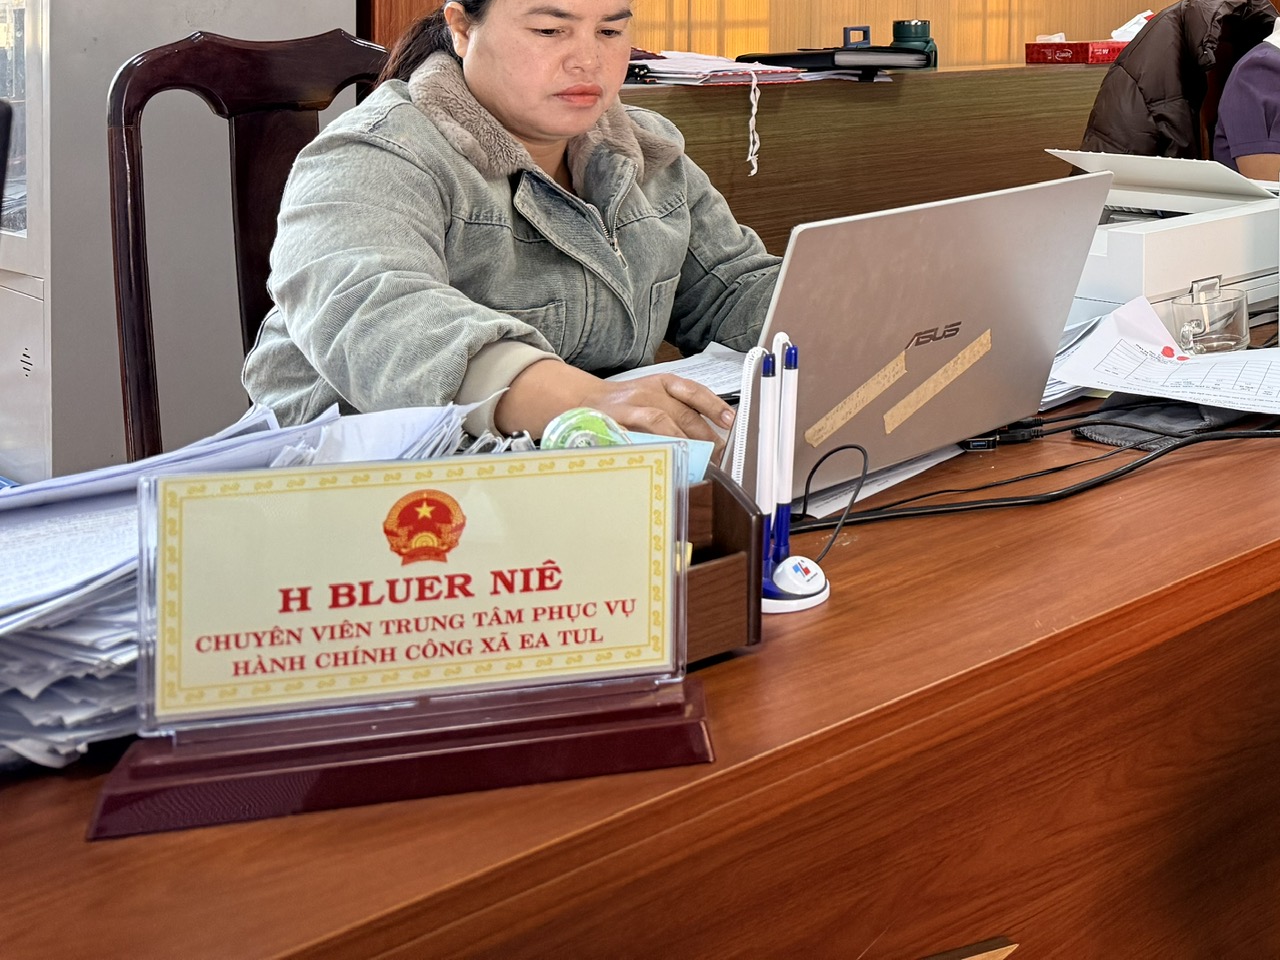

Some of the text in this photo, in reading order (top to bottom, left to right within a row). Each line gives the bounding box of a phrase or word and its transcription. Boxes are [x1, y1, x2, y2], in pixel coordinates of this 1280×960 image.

[905, 321, 961, 349] ASUS
[279, 559, 563, 614] H BLUER NIÊ
[195, 598, 637, 654] CHUYÊN VIÊN TRUNG TÂM PHỤC VỤ
[232, 627, 604, 678] HÀNH CHÍNH CÔNG XÃ EA TUL
